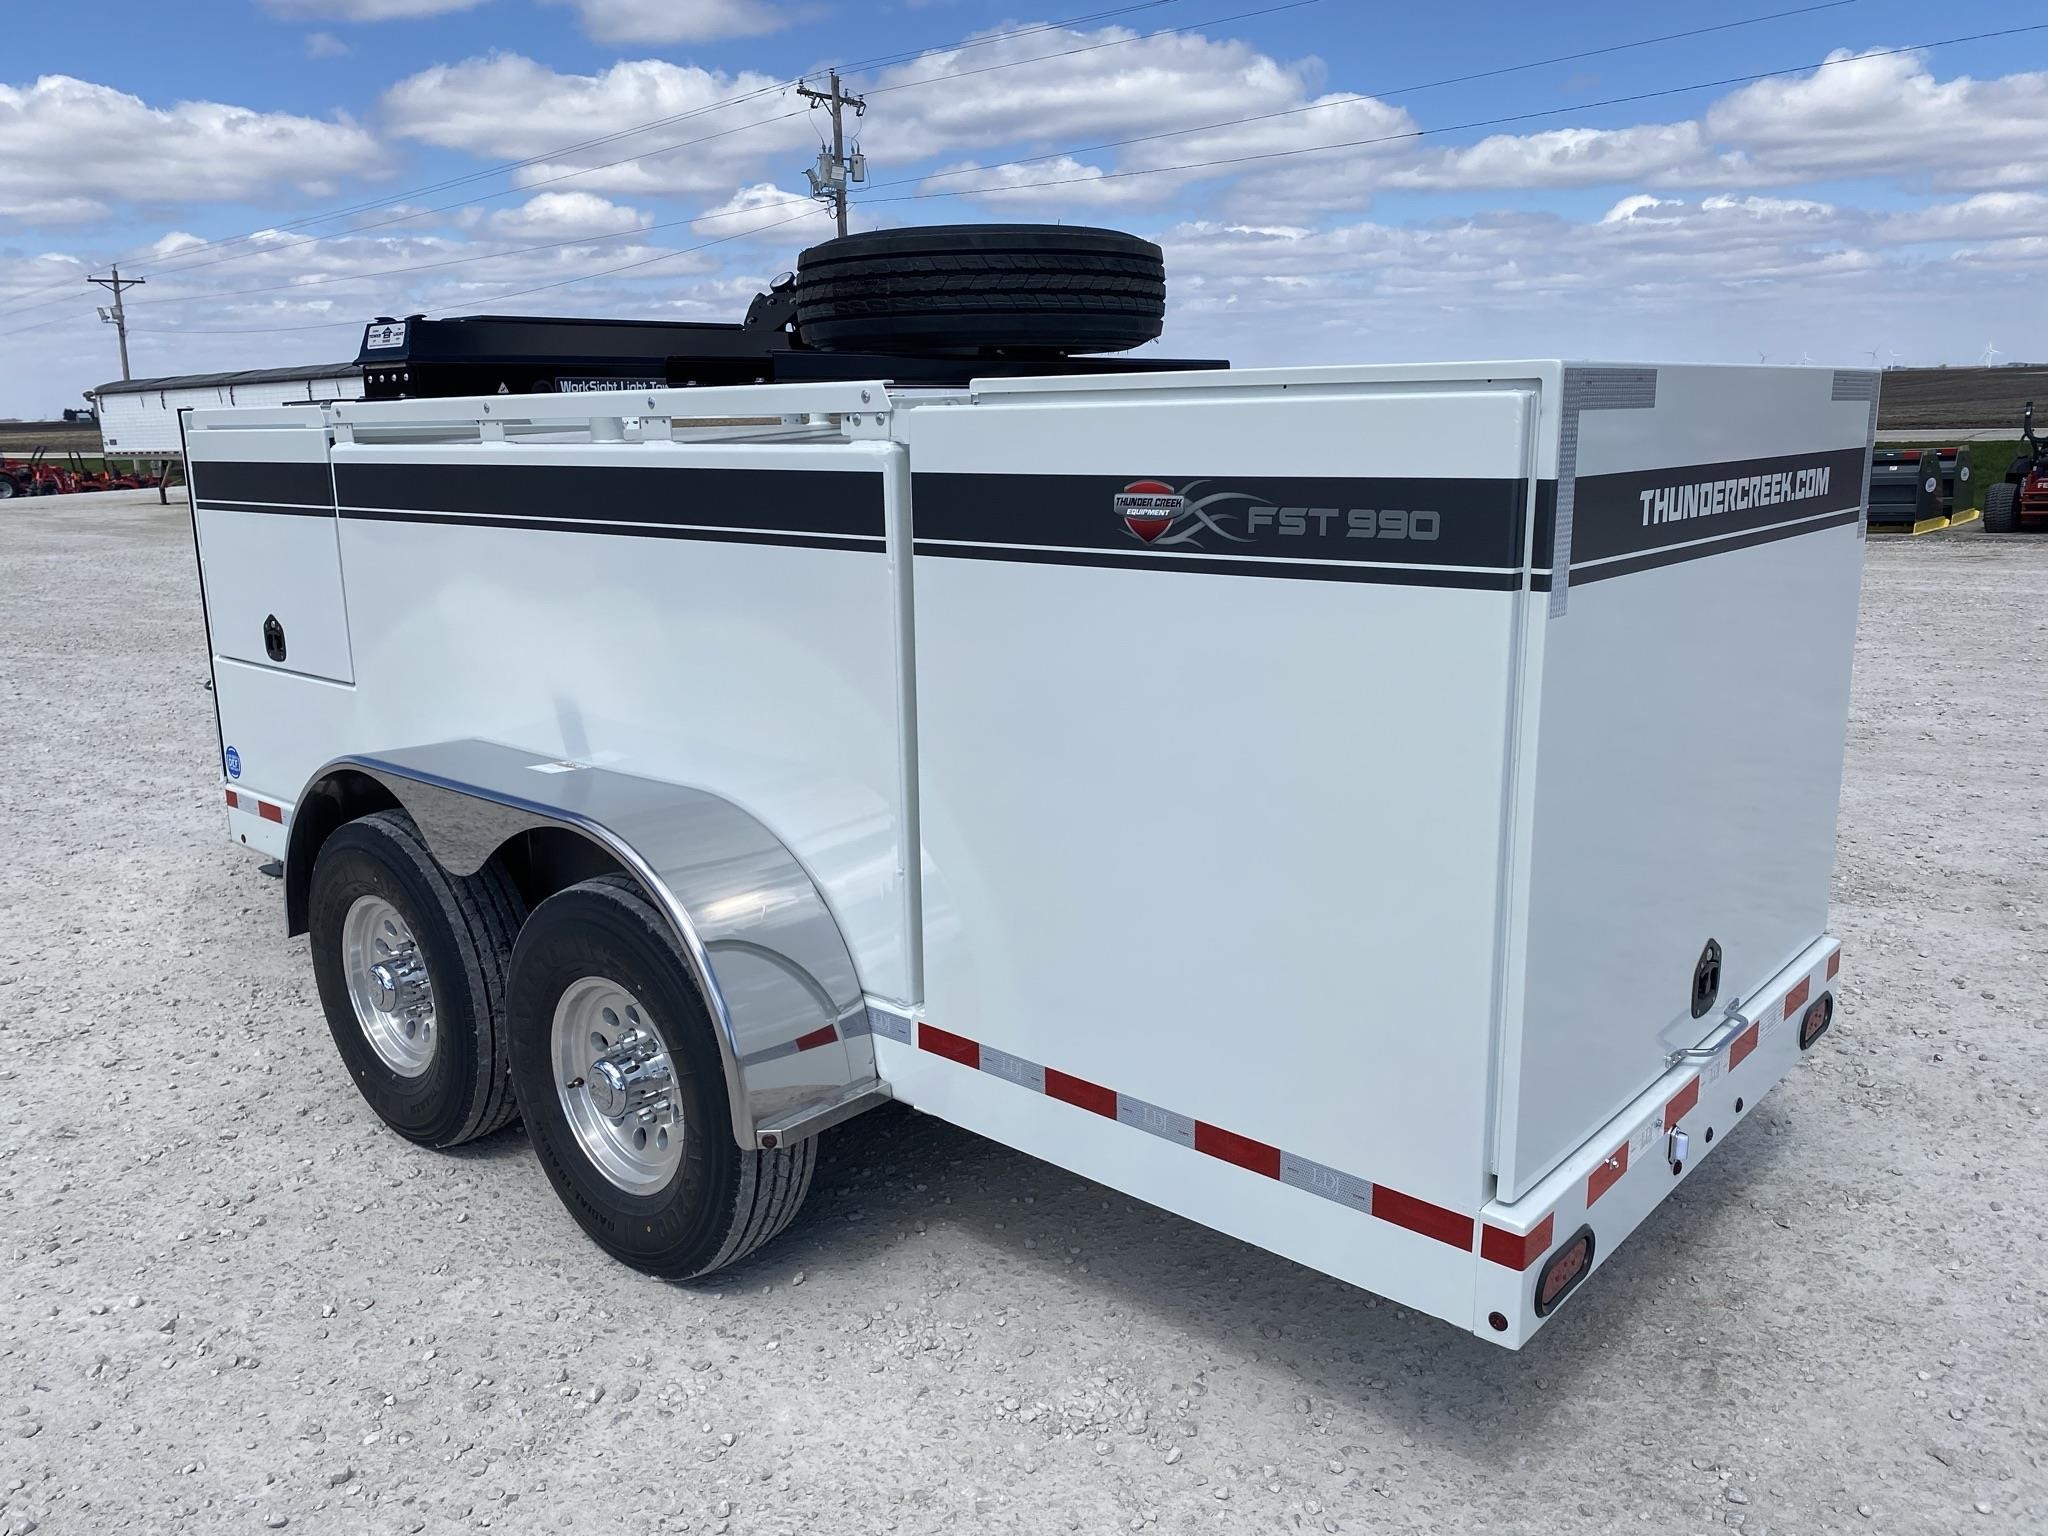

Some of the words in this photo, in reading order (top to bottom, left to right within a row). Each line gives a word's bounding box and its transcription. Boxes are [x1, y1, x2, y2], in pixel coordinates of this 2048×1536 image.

[560, 380, 618, 392] WorkSight
[620, 381, 646, 391] Light
[1640, 466, 1831, 526] THUNDERCREEK.COM
[1116, 497, 1153, 507] THUNDER
[1154, 499, 1183, 508] CREEK
[1126, 508, 1170, 516] EQUIPMENT
[1248, 506, 1339, 537] FST
[1346, 509, 1441, 541] 990
